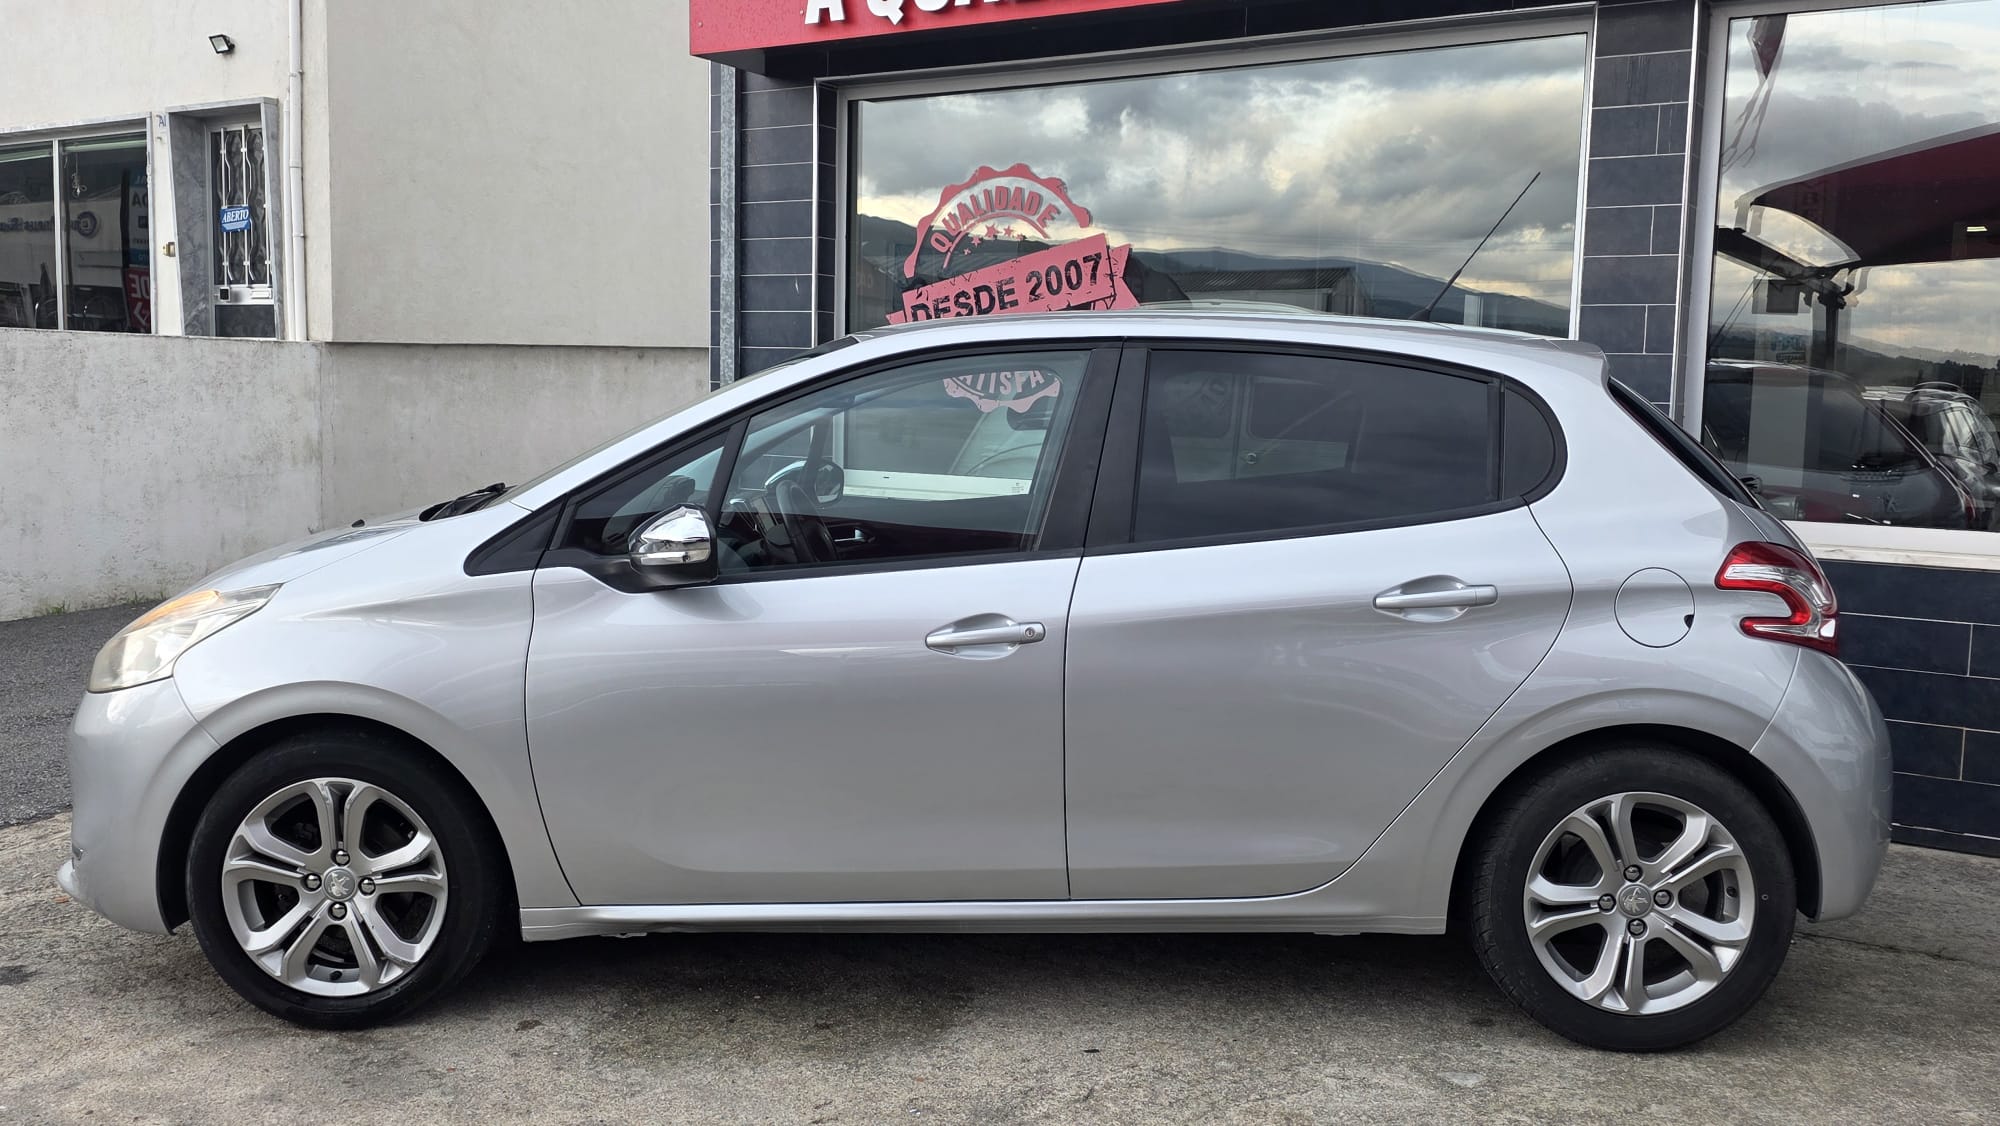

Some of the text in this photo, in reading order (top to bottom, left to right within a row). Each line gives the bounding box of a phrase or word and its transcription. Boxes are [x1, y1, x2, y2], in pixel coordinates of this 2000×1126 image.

[221, 209, 249, 224] ABERTO
[930, 185, 1062, 253] QUALIDADE
[910, 252, 1102, 322] DESDE 2007
